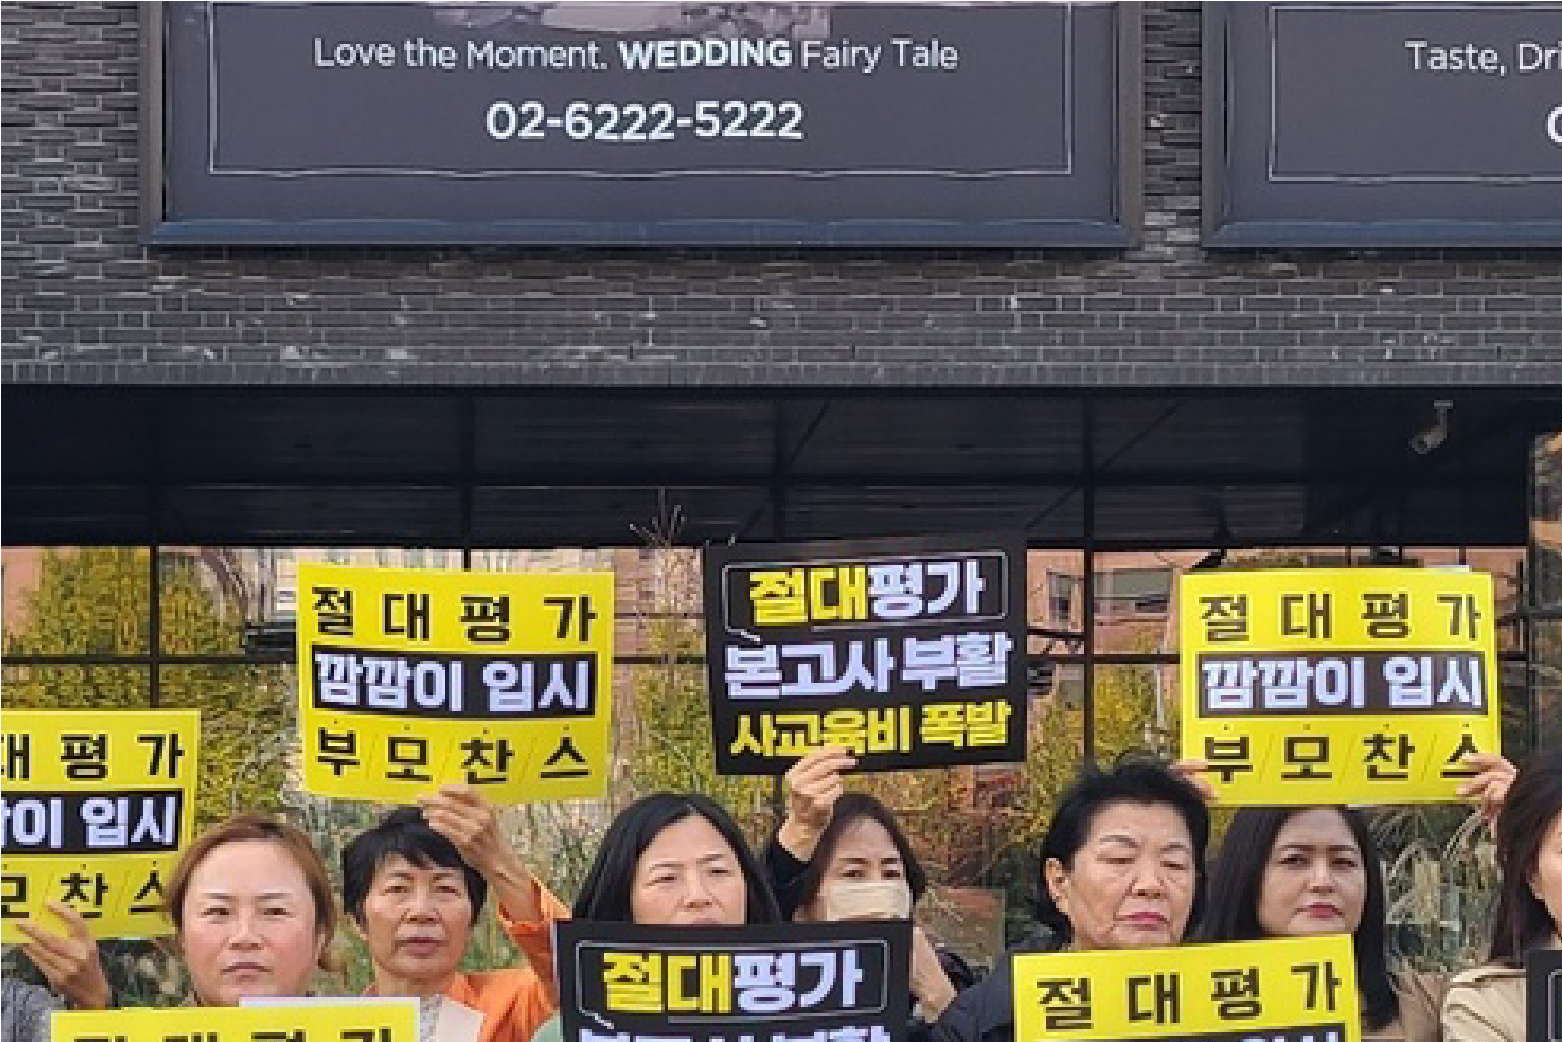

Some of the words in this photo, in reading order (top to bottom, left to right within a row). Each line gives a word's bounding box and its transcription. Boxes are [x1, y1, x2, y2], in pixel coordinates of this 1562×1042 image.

[314, 39, 396, 68] Love
[404, 39, 457, 68] the
[468, 41, 606, 70] Moment.
[619, 39, 793, 68] WEDDING
[802, 40, 881, 73] Fairy
[894, 39, 958, 69] Tale
[1405, 41, 1508, 75] Taste,
[487, 101, 803, 141] 02-6222-5222
[748, 559, 986, 627] 절대평가
[314, 653, 464, 711] 깜깜이
[481, 660, 592, 712] 입시
[724, 638, 897, 700] 본고사
[903, 632, 1014, 692] 부활
[1202, 656, 1366, 709] 깜깜이
[1382, 656, 1483, 708] 입시
[730, 706, 910, 757] 사교육비
[919, 699, 1014, 747] 폭발
[80, 795, 176, 847] 입시
[603, 948, 864, 1013] 절대평가
